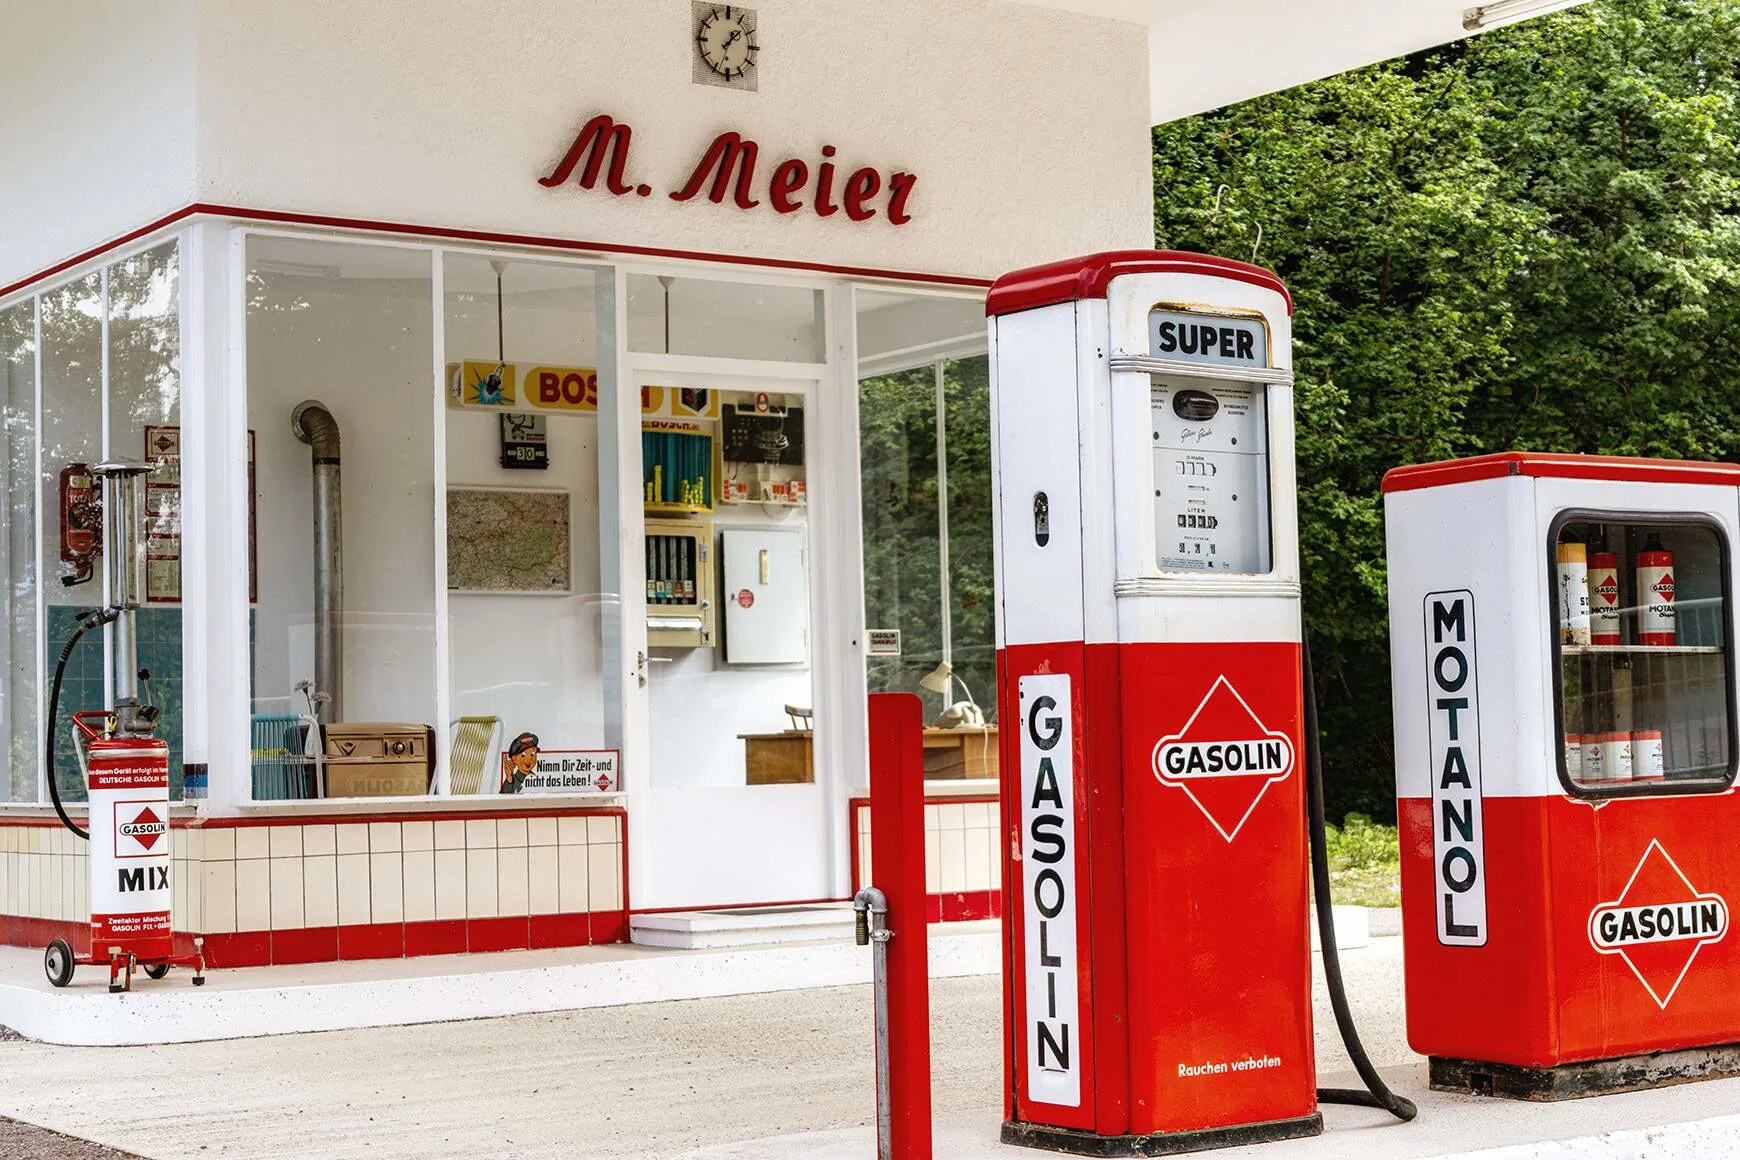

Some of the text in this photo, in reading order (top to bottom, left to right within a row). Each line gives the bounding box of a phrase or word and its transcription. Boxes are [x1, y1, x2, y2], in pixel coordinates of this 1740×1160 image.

[537, 114, 918, 226] M. Meier
[1159, 321, 1254, 360] SUPER
[518, 447, 533, 459] 30
[536, 759, 560, 772] Nimm
[562, 759, 574, 772] Dir
[596, 759, 612, 771] und
[1165, 741, 1282, 774] GASOLIN
[132, 767, 152, 776] erfolgt
[1432, 599, 1479, 938] MOTANOL
[99, 776, 133, 784] DEUTSCHE
[133, 775, 160, 783] GASOLIN
[525, 775, 545, 788] nicht
[546, 774, 561, 787] das
[123, 823, 166, 834] GASOLIN
[118, 866, 169, 892] MIX
[1028, 695, 1070, 1070] GASOLIN
[108, 917, 141, 925] Zweitakter
[142, 915, 167, 924] Mischung
[111, 924, 141, 932] GASOLIN
[1599, 902, 1720, 944] GASOLIN
[1178, 1055, 1281, 1078] Rauchen verboten
